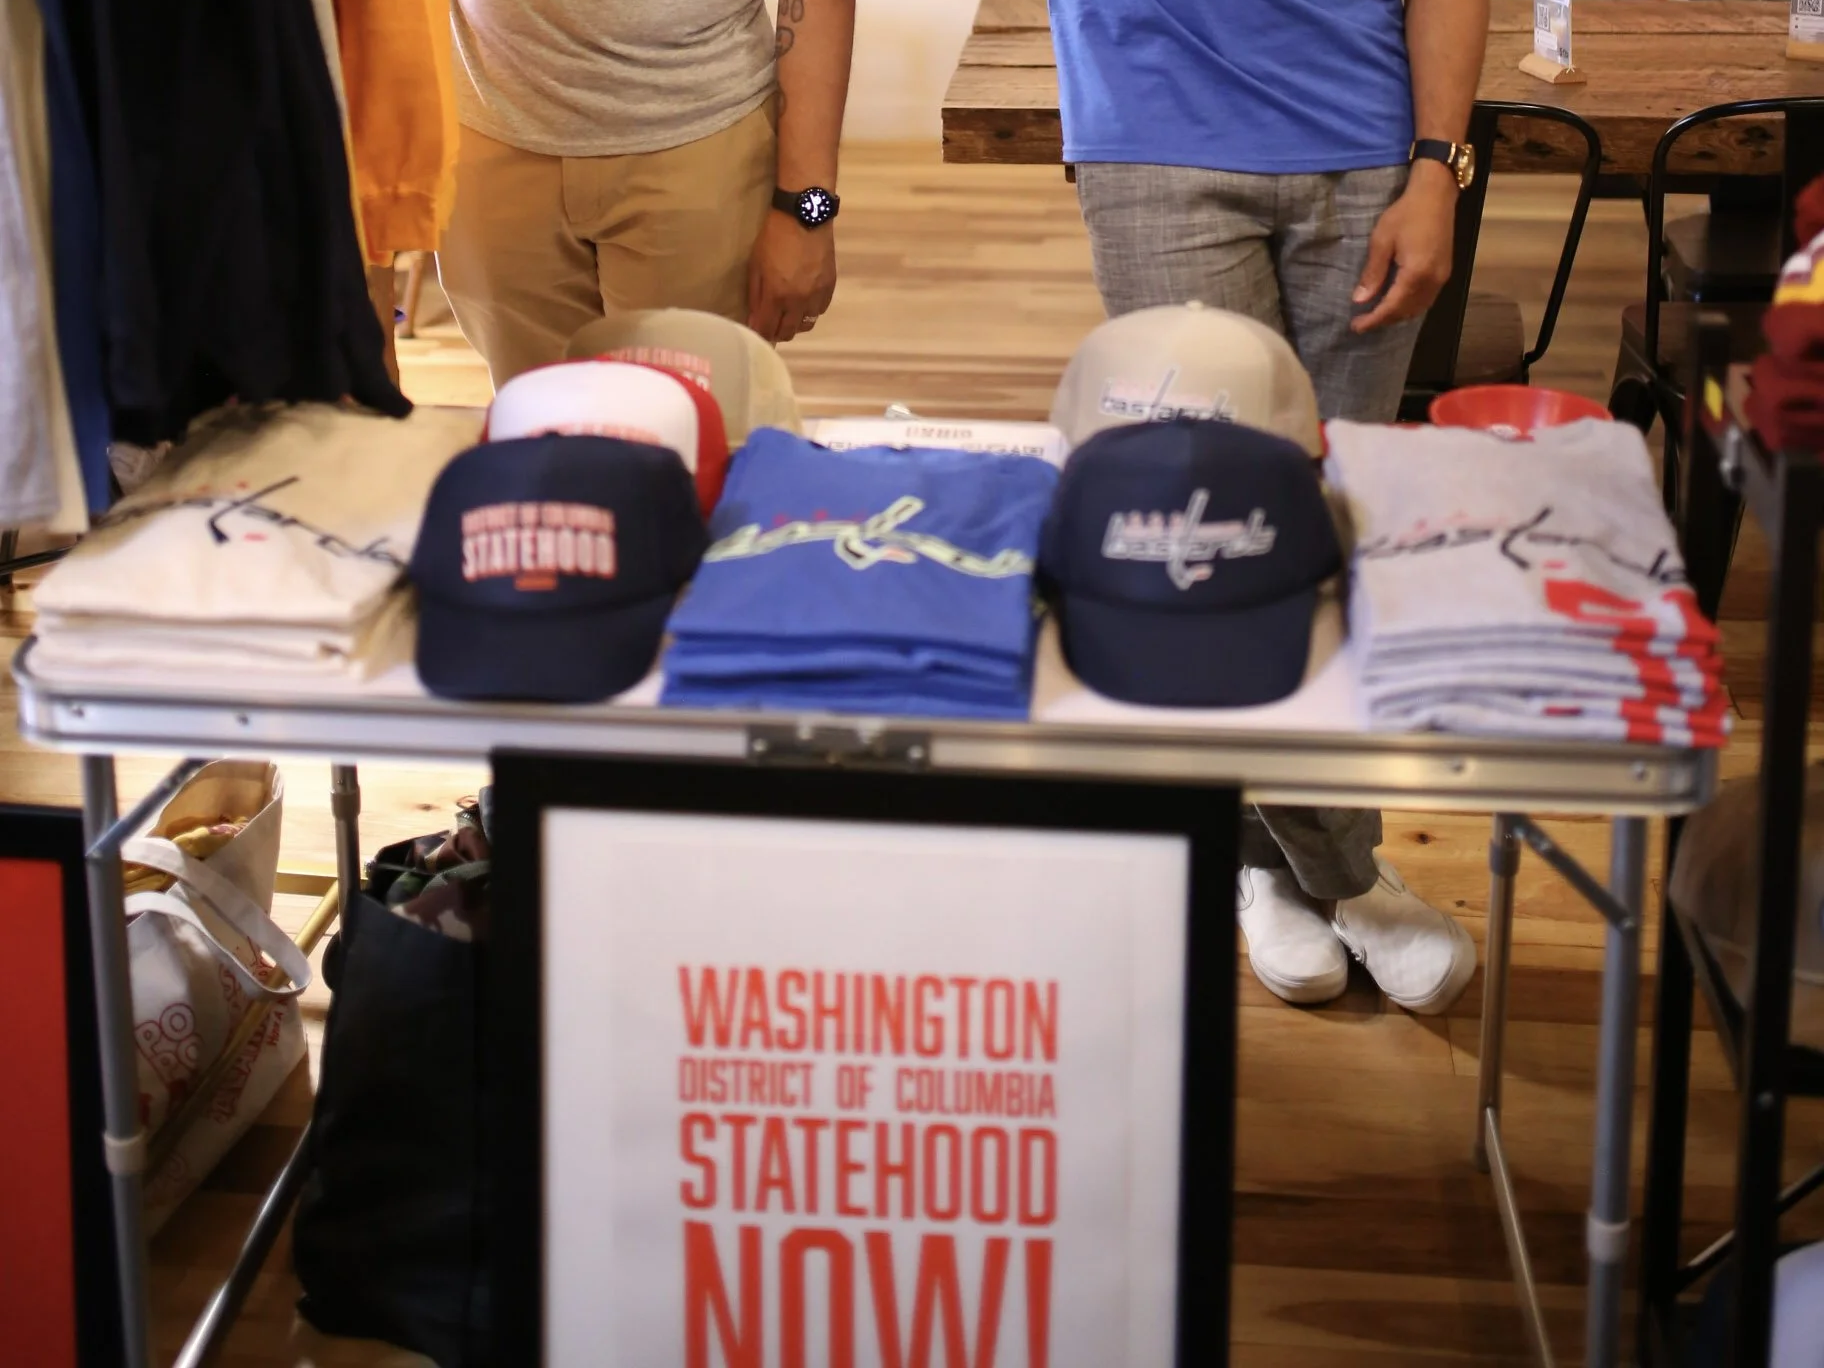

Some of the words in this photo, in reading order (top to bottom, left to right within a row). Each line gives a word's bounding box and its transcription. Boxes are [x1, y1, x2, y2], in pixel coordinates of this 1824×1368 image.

[462, 526, 617, 582] STATEHOOD
[676, 965, 1059, 1063] WASHINGTON
[677, 1056, 815, 1109] DISTRICT
[834, 1064, 874, 1111] OF
[896, 1065, 1058, 1119] COLUMBIA
[679, 1111, 1059, 1228] STATEHOOD
[683, 1218, 1054, 1368] NOW!
